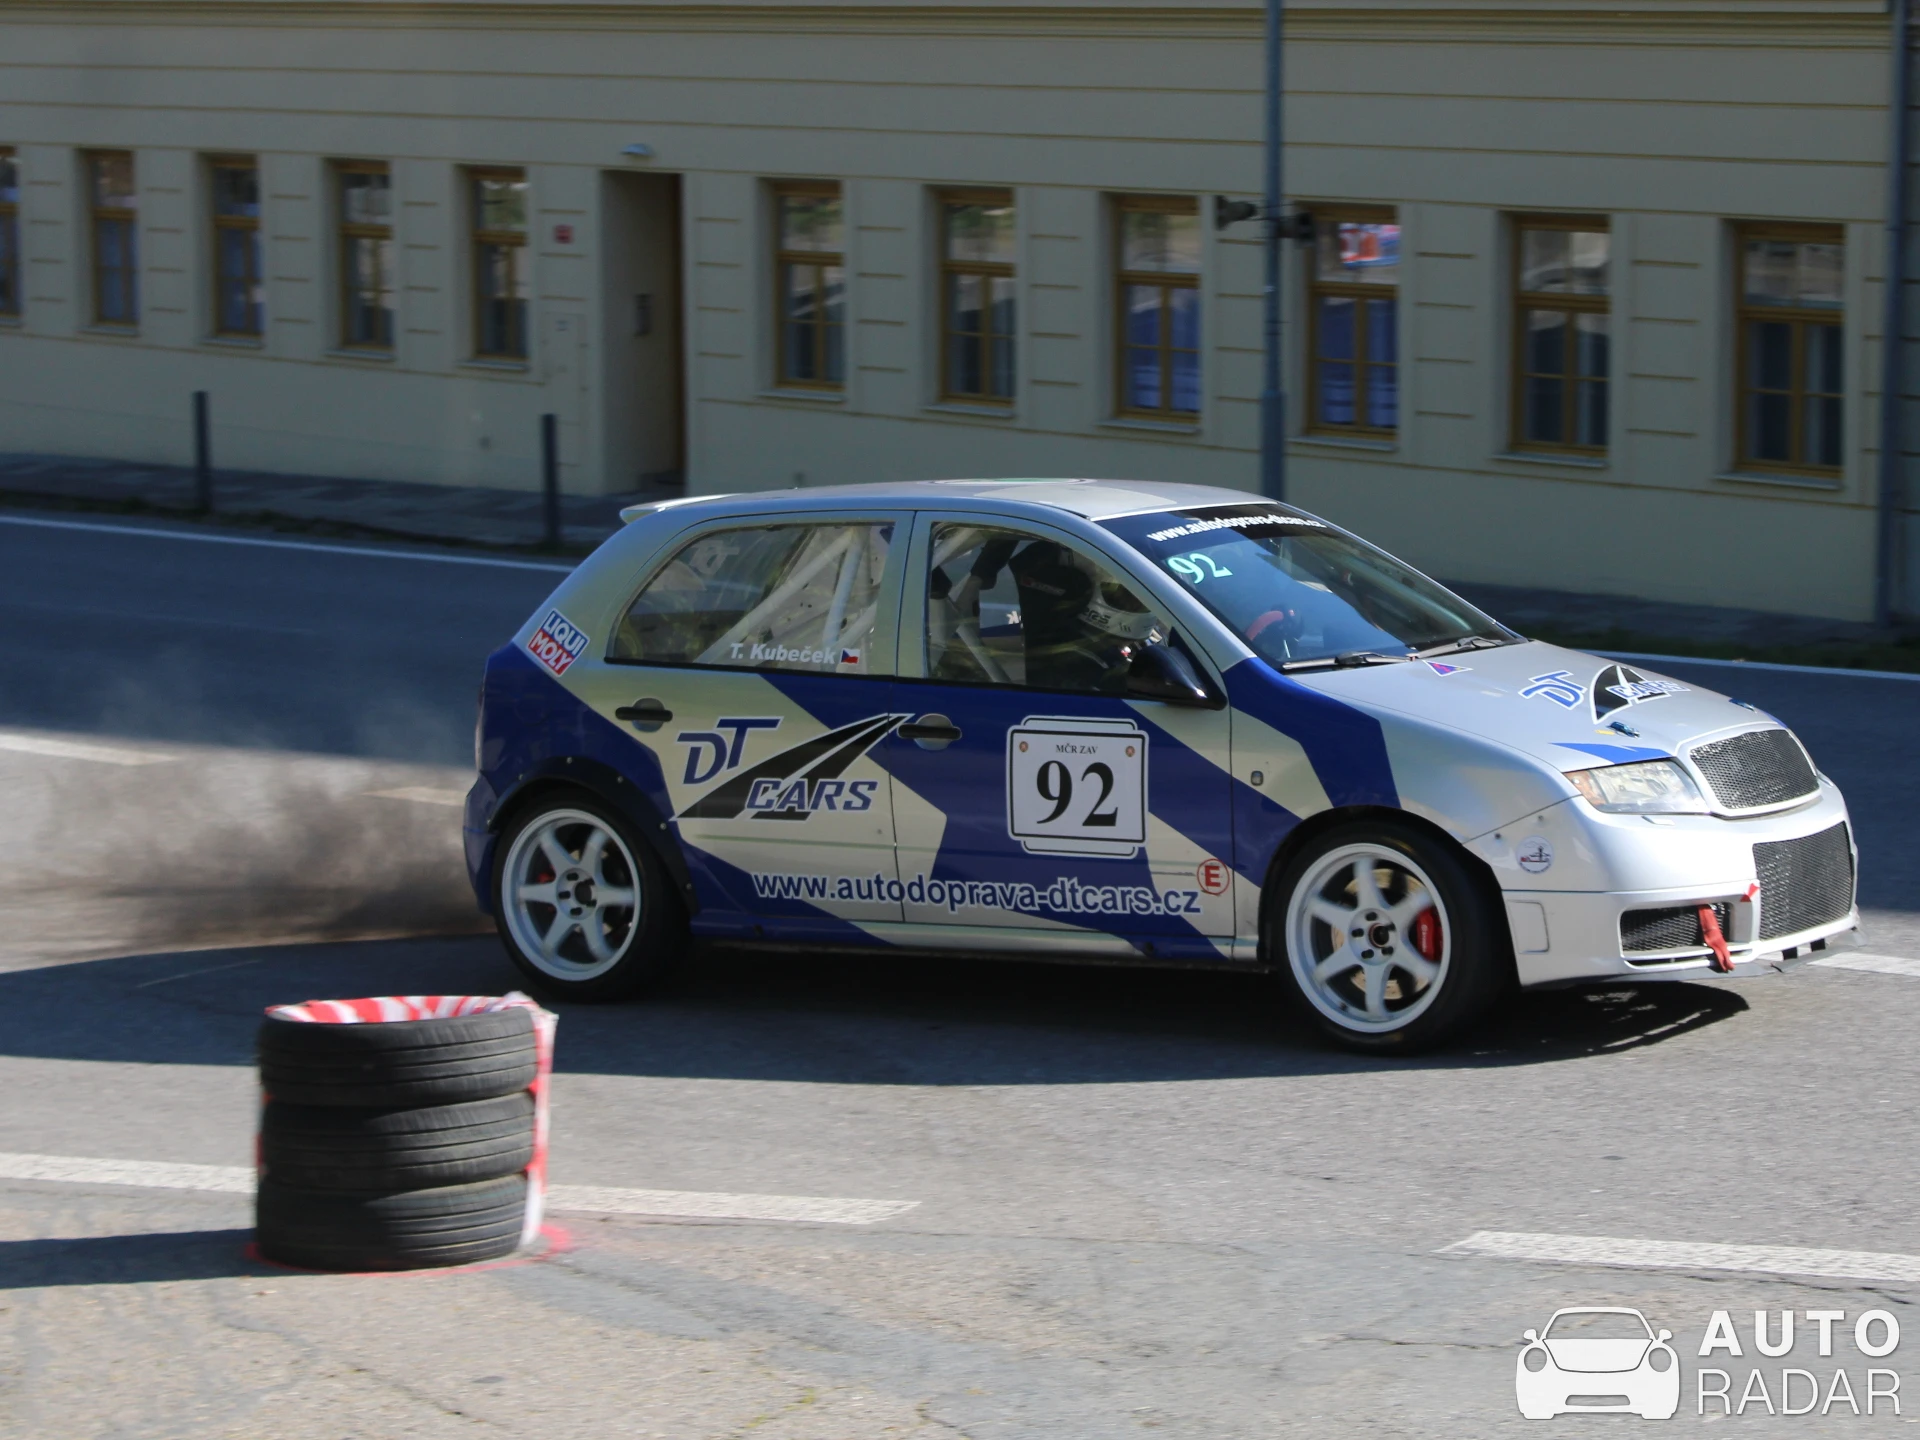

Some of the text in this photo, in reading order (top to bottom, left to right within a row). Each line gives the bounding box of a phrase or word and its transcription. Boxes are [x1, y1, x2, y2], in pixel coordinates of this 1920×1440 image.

[1167, 552, 1233, 584] 92
[530, 631, 572, 671] MOLY
[543, 612, 586, 656] LIQUI
[730, 642, 836, 664] T. Kubeček
[1518, 670, 1588, 710] DT
[677, 717, 783, 785] DT
[1055, 743, 1098, 755] MČR ZAV
[746, 778, 878, 812] CARS
[1036, 760, 1118, 826] 92
[752, 873, 1202, 914] www.autodoprava-dtcars.cz
[1203, 865, 1221, 887] E
